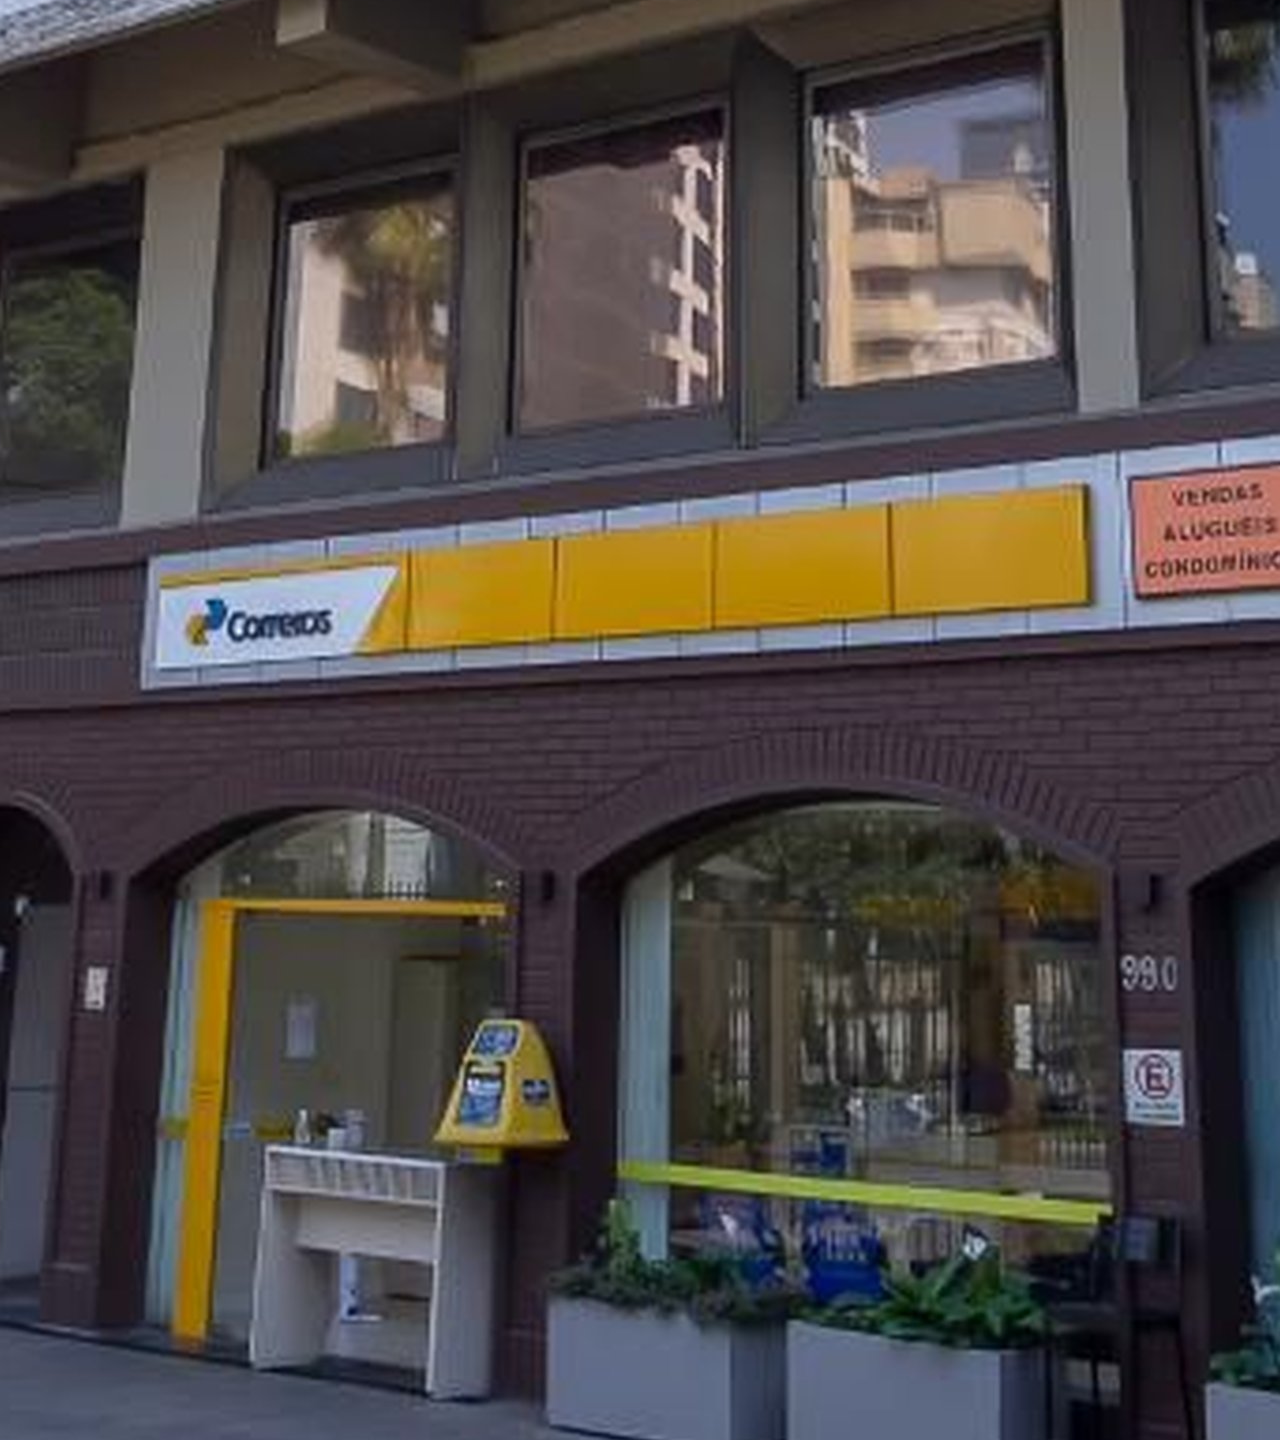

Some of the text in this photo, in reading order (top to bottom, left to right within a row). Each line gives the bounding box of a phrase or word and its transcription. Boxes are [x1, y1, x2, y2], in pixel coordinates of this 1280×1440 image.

[1171, 482, 1264, 507] VENDAS
[227, 610, 333, 643] Correios
[1121, 954, 1179, 991] 990
